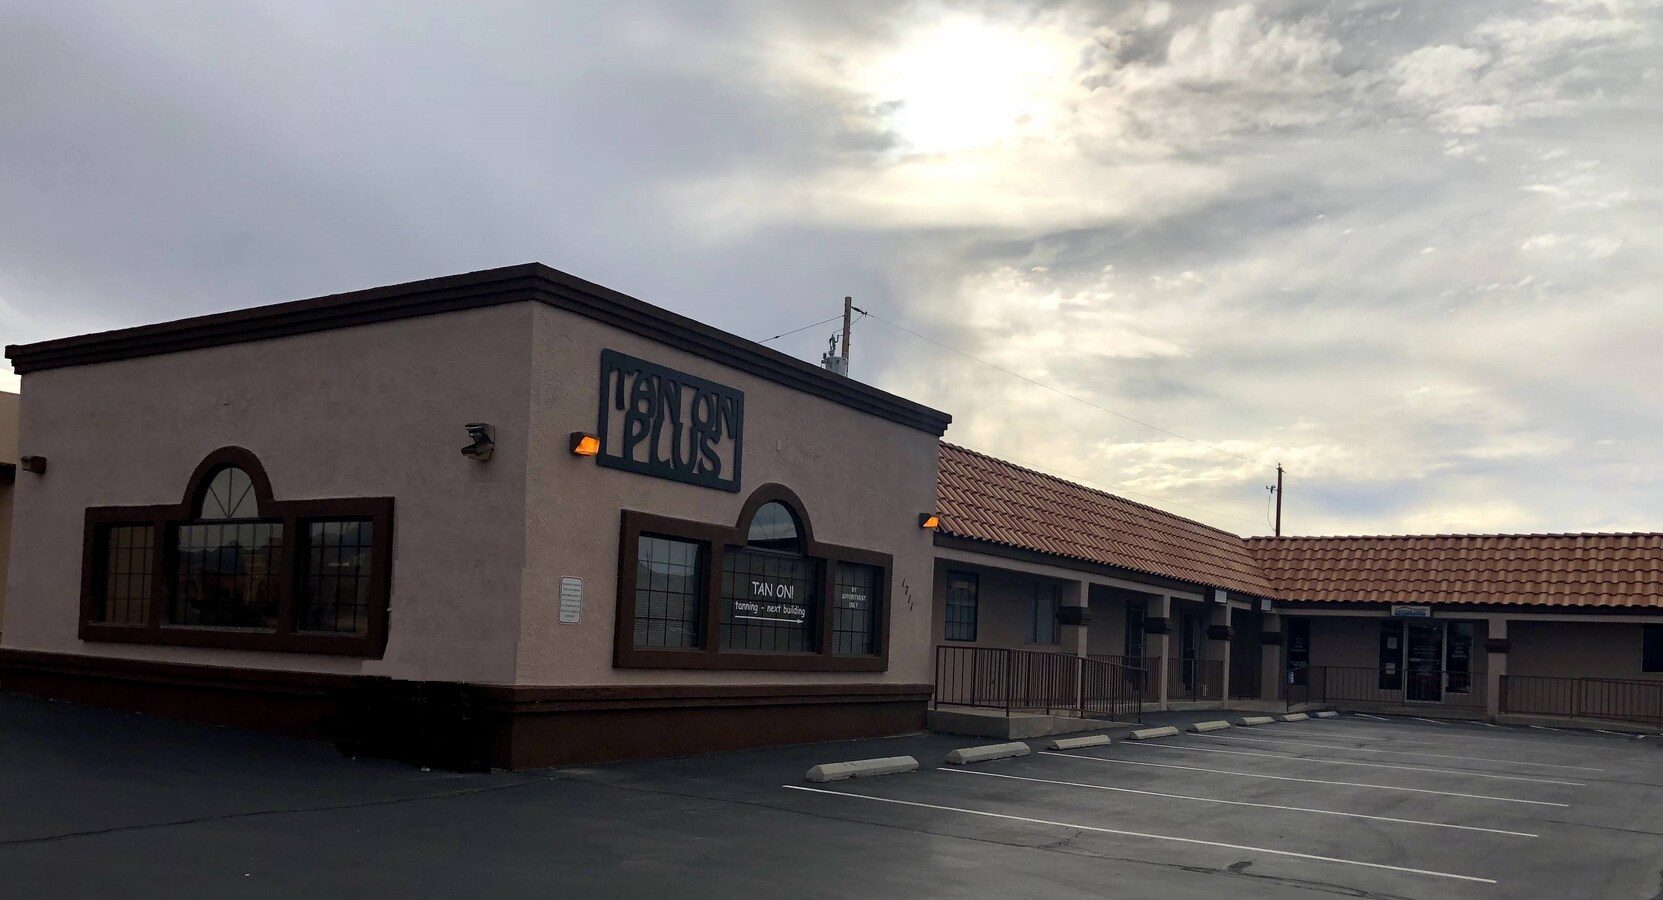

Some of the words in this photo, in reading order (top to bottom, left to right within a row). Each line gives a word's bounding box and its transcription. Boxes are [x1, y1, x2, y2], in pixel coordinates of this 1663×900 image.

[609, 361, 683, 424] TAN
[692, 386, 738, 440] ON
[623, 408, 722, 479] PLUS
[734, 601, 759, 614] tanning
[766, 604, 781, 614] next
[783, 604, 806, 618] building
[751, 581, 773, 597] TAN
[776, 584, 794, 599] ON!
